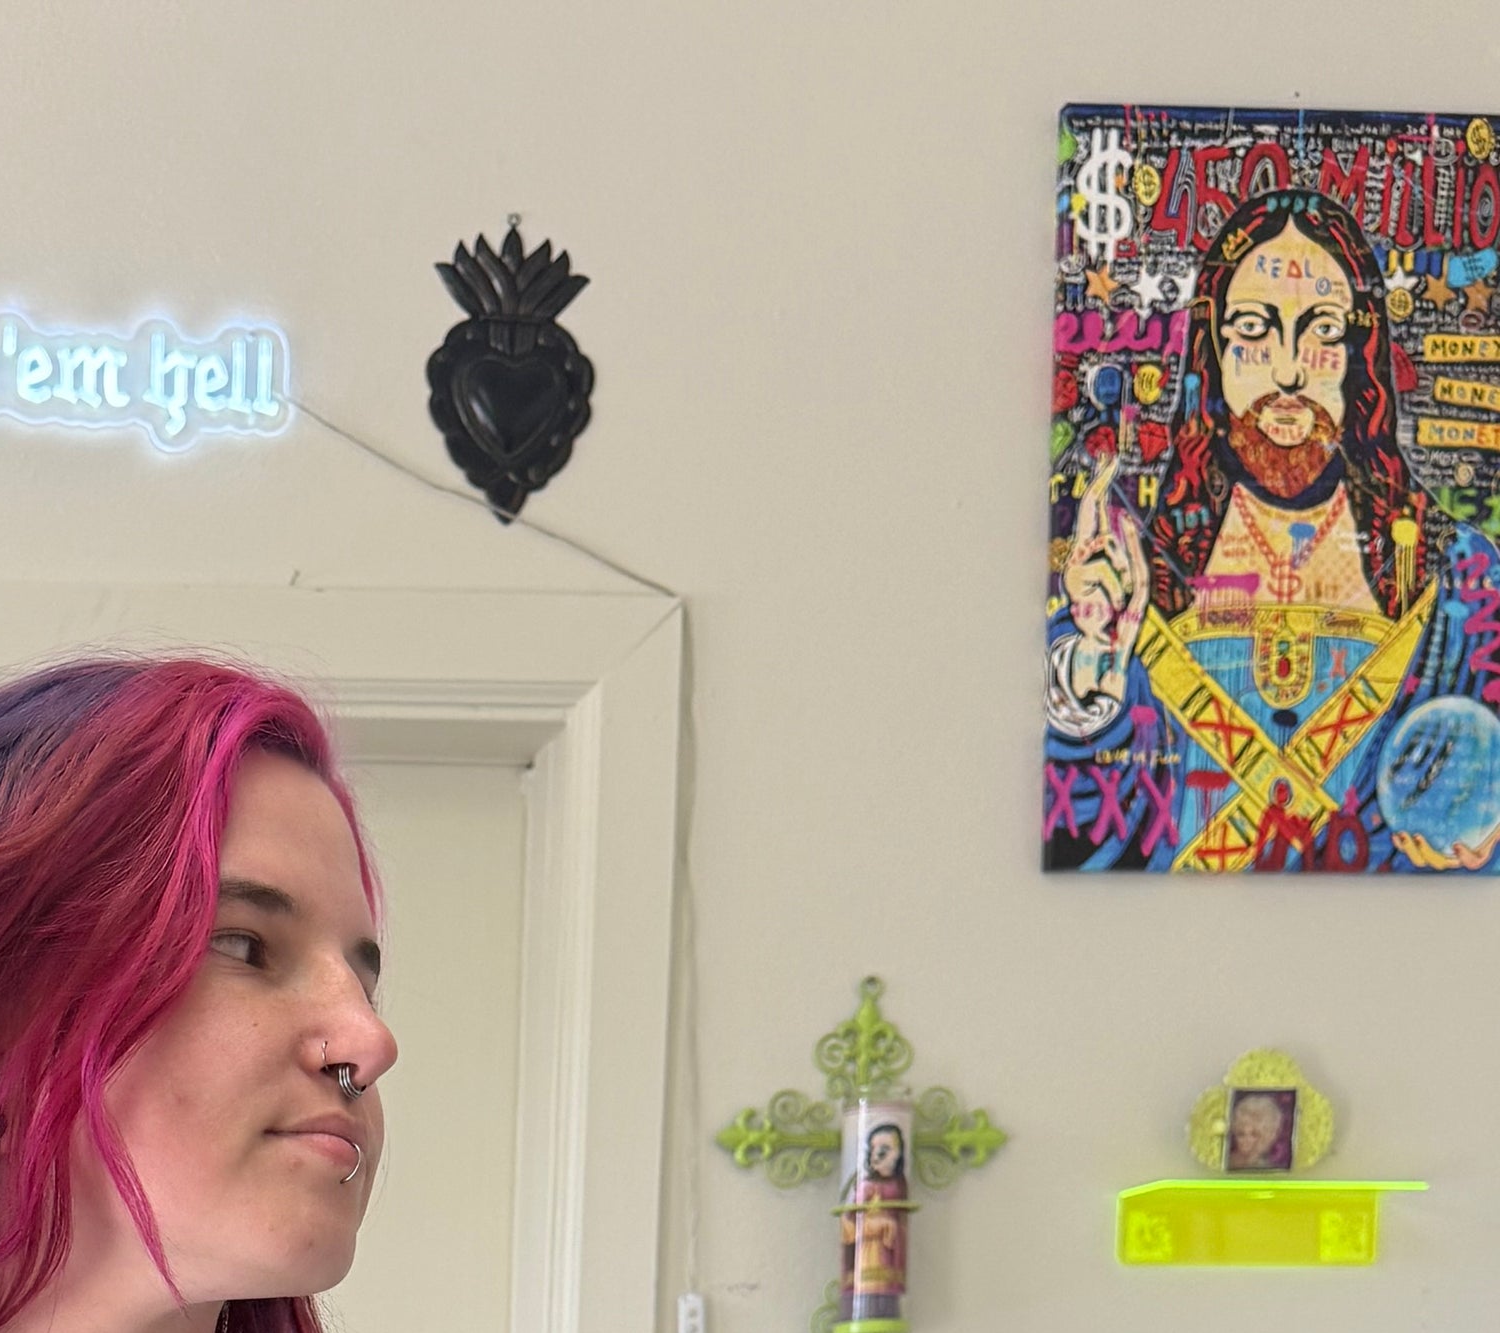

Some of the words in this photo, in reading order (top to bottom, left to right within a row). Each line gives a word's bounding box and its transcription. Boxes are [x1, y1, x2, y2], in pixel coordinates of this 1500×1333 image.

[1319, 146, 1500, 251] MILLIO
[1255, 254, 1315, 280] REAL
[1301, 348, 1342, 371] LIFE
[2, 322, 131, 409] 'em
[143, 331, 280, 436] hell
[1440, 383, 1500, 404] MONE
